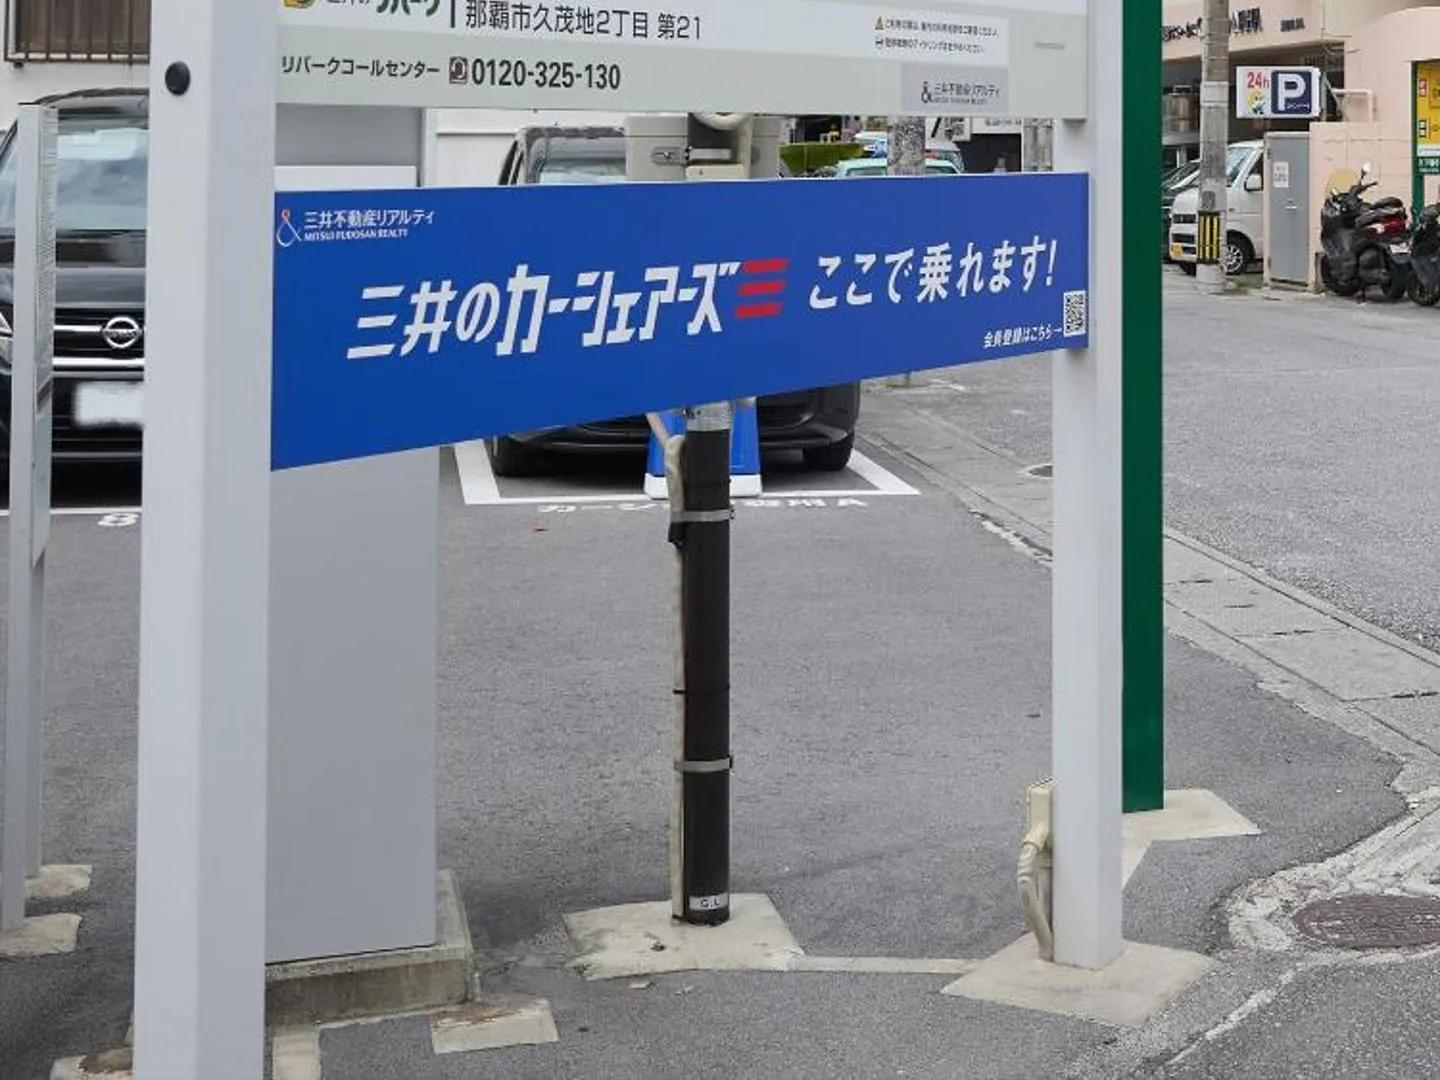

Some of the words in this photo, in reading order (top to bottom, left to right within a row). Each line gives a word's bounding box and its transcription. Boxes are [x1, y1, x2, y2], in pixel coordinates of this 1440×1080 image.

[657, 12, 701, 40] 第21
[281, 55, 440, 79] リパークコールセンター
[471, 58, 621, 89] 0120-325-130
[1247, 72, 1270, 88] 24h
[1277, 73, 1306, 111] P
[304, 209, 435, 229] 三井不動産リアルティ
[304, 231, 334, 241] MITSUI
[336, 230, 377, 241] FUDOSAN
[346, 259, 741, 361] 三井のカーシェアーズ
